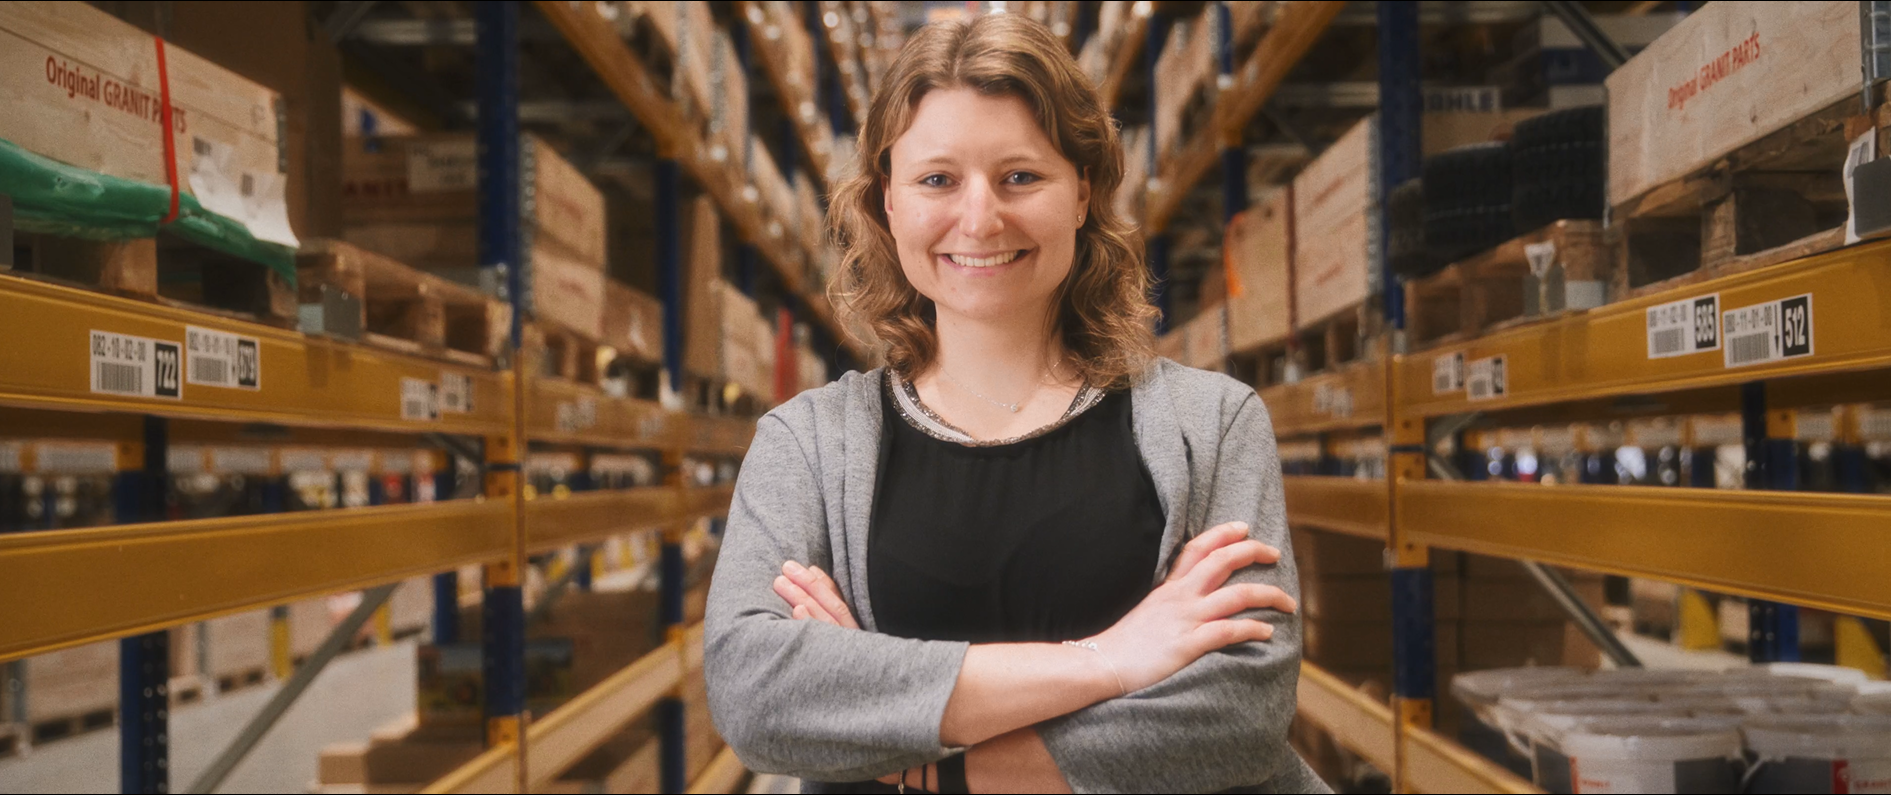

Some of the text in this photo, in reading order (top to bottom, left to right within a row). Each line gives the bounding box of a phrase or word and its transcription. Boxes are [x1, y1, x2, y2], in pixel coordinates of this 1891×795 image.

[46, 56, 187, 133] Original GRANIT PTS
[1667, 33, 1760, 110] Original GRANIT PARTS
[1785, 305, 1805, 348] 512
[157, 349, 176, 389] 722
